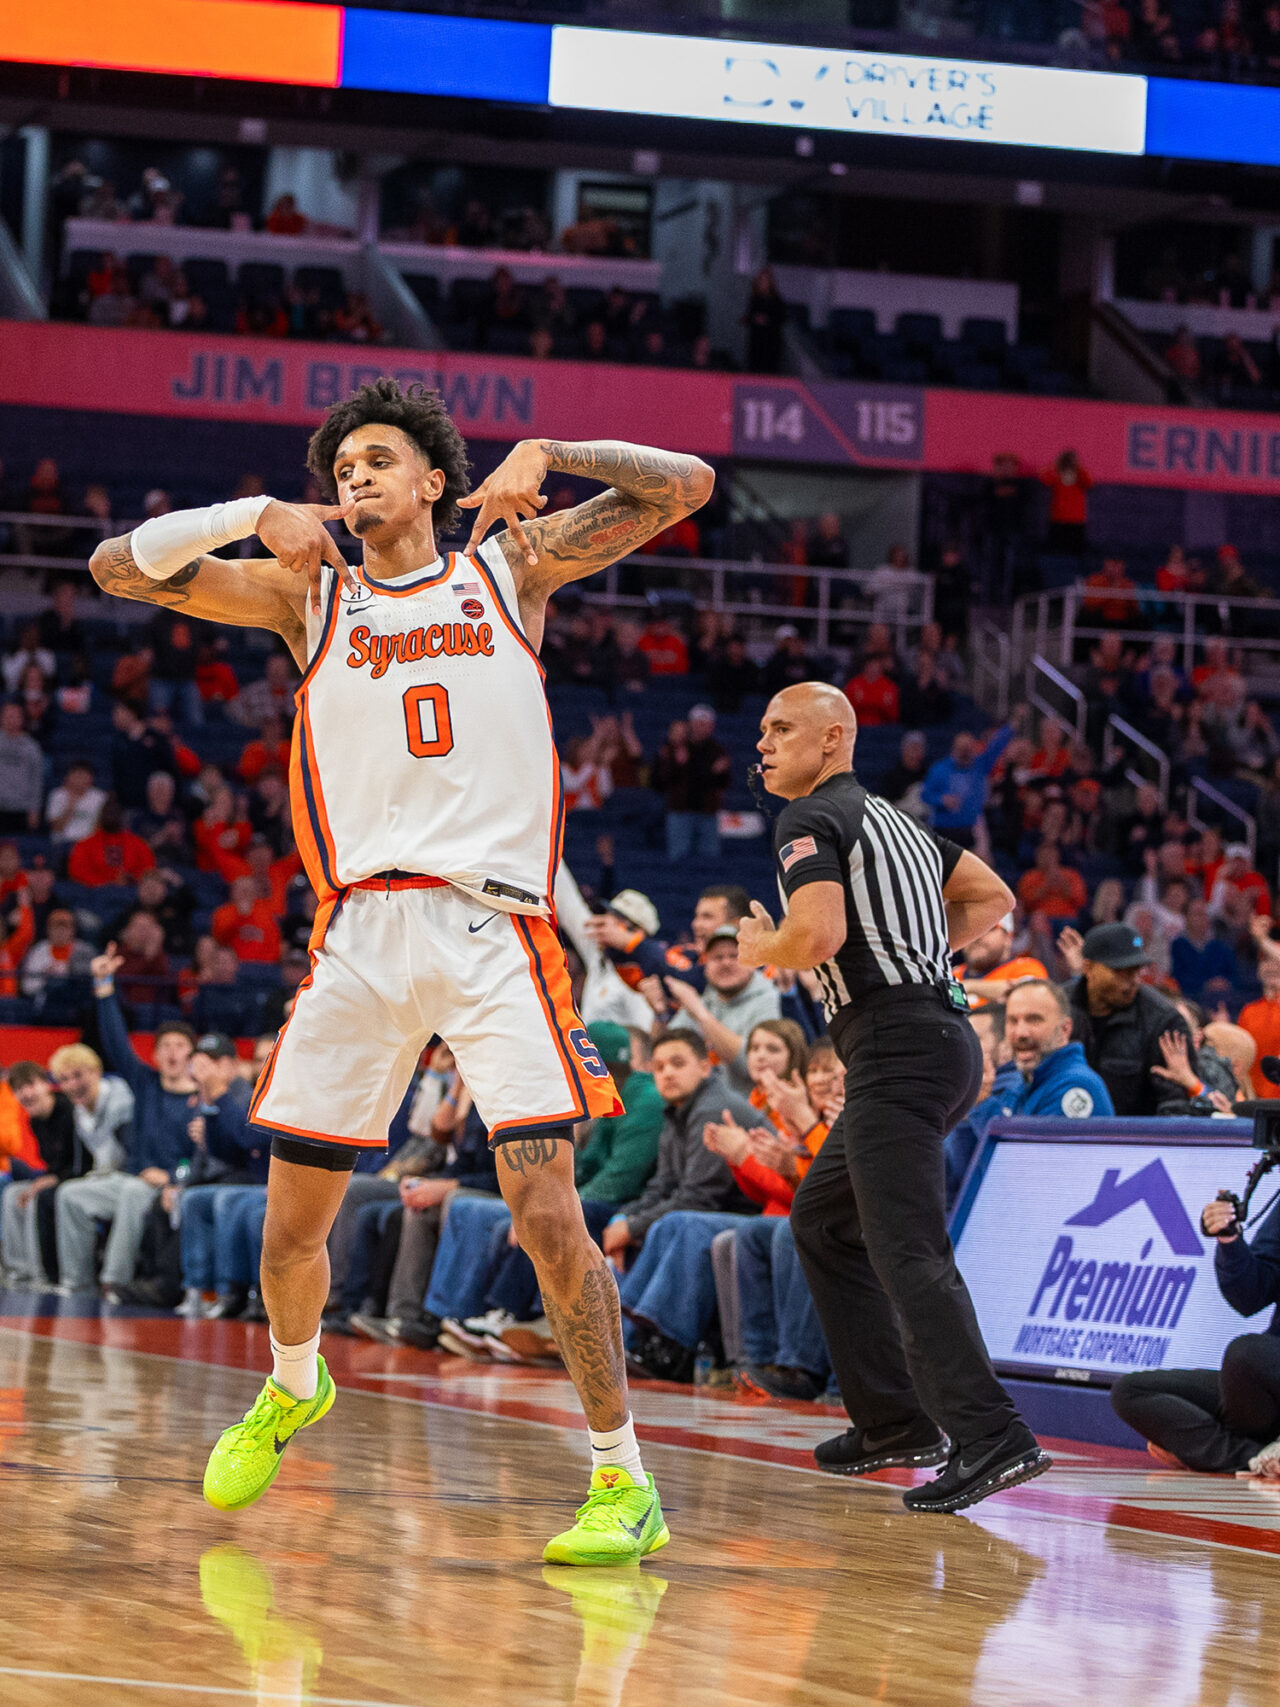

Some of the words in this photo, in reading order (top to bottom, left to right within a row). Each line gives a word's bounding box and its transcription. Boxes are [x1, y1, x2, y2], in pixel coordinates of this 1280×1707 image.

[844, 60, 997, 97] DRIVER'S
[845, 96, 995, 131] VILLAGE
[173, 353, 283, 407] JIM
[743, 398, 806, 444] 114
[856, 399, 917, 444] 115
[346, 622, 495, 680] Syracuse
[402, 682, 455, 759] 0
[568, 1027, 610, 1079] S
[1027, 1235, 1197, 1330] Premium
[1012, 1323, 1085, 1360] MORTGAGE
[1078, 1329, 1172, 1368] CORPORATION
